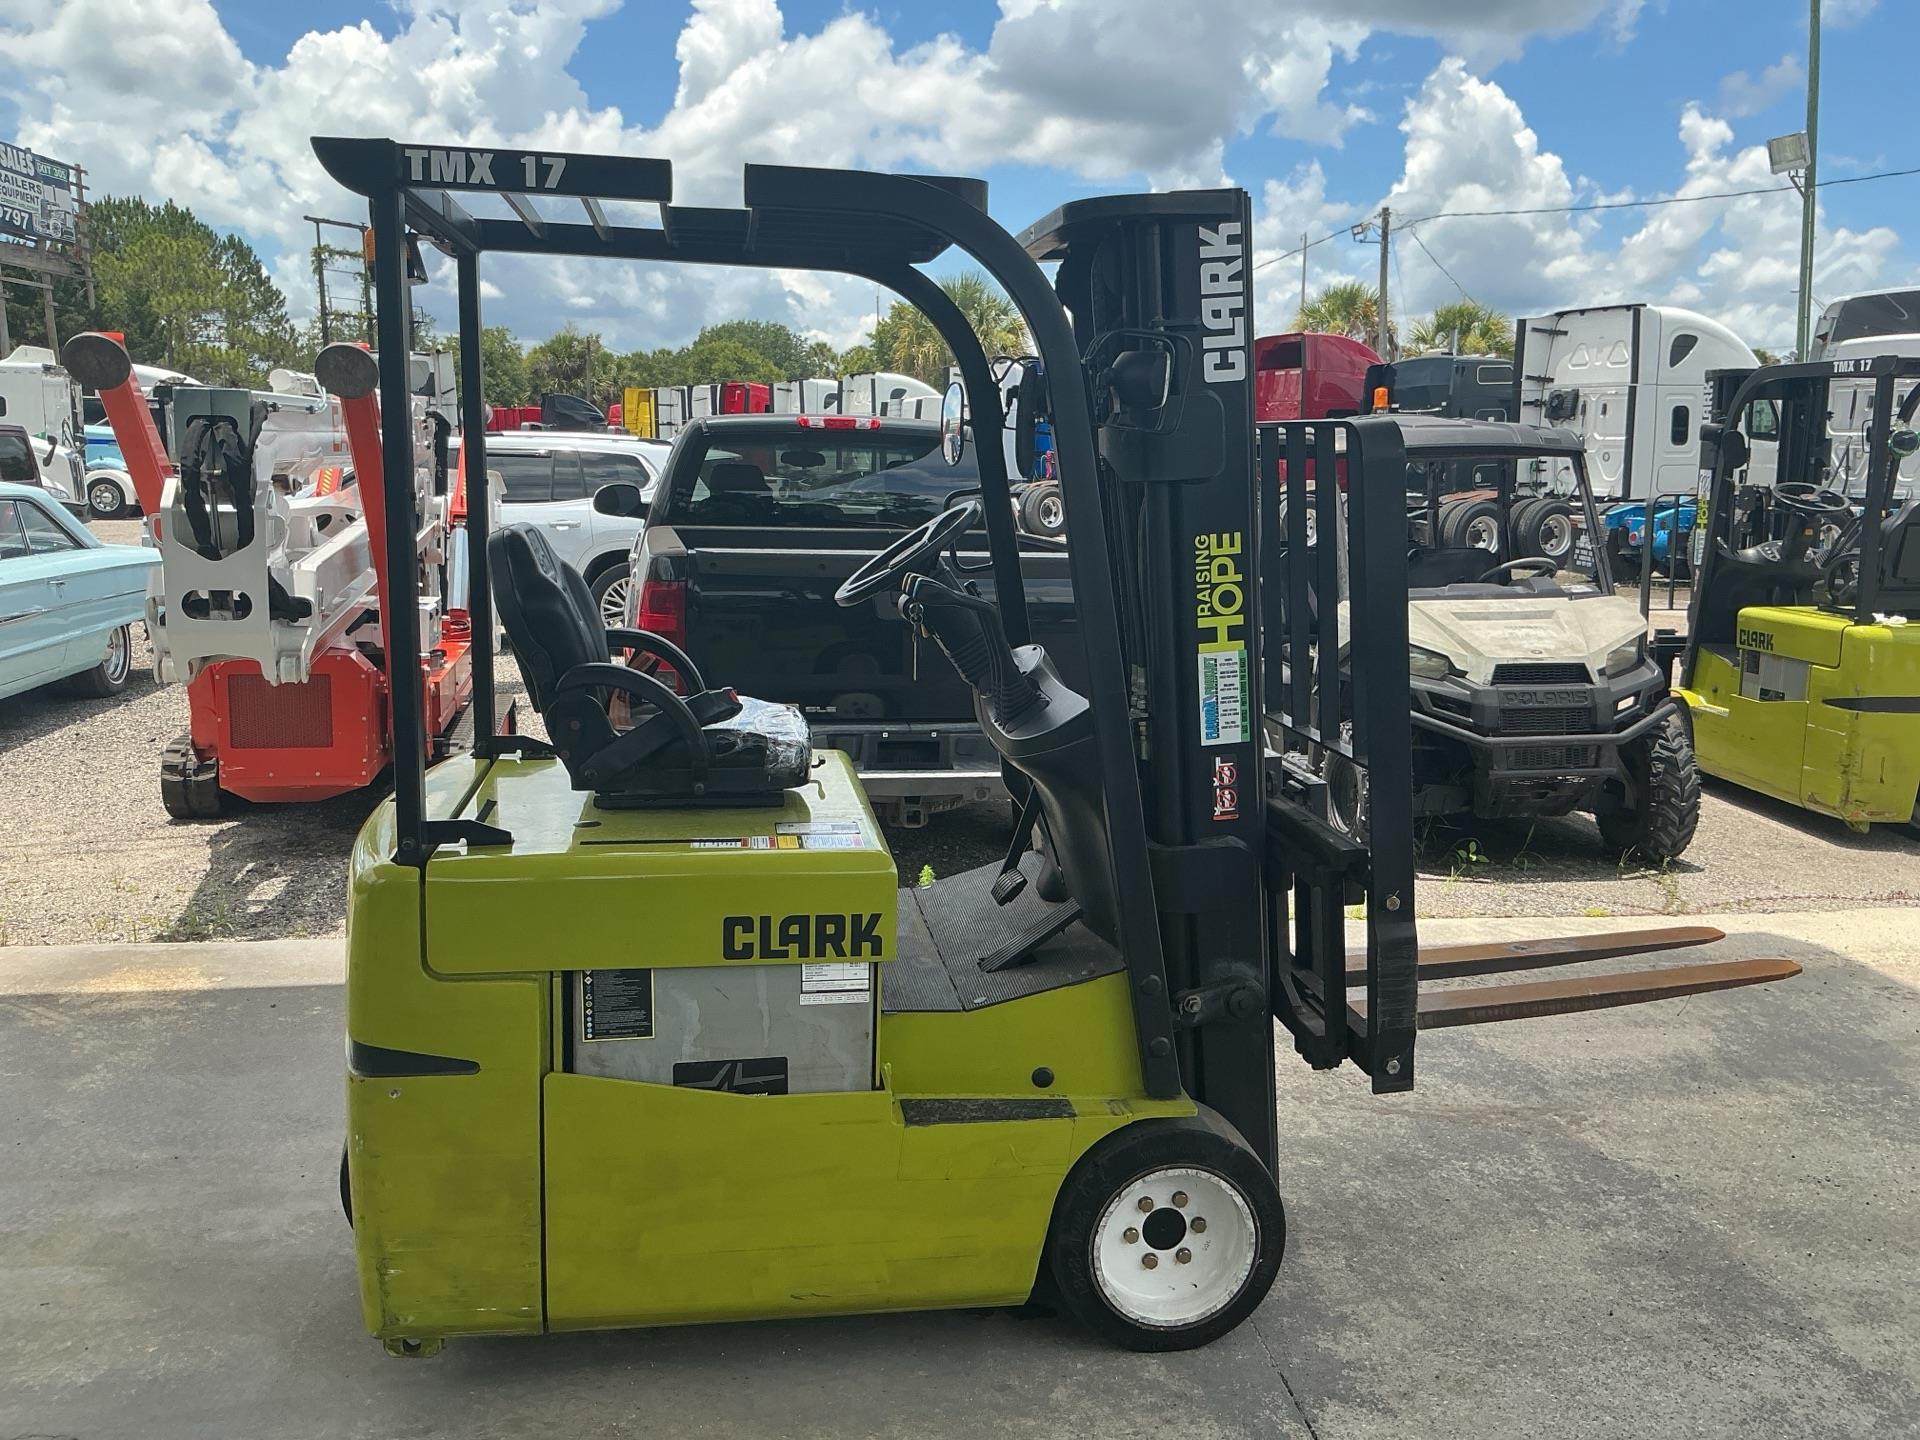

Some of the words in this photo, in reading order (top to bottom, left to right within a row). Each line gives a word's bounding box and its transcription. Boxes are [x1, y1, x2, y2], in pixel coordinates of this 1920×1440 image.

[0, 143, 35, 177] SALES
[404, 149, 496, 185] TMX
[520, 155, 567, 189] 17
[1199, 222, 1246, 383] CLARK
[1833, 360, 1855, 373] TMX
[1860, 359, 1872, 372] 17
[1702, 380, 1714, 425] LARK
[1194, 534, 1211, 616] RAISING
[1197, 531, 1244, 653] HOPE
[1739, 629, 1774, 651] CLARK
[1502, 690, 1588, 705] POLARIS
[722, 912, 883, 960] CLARK
